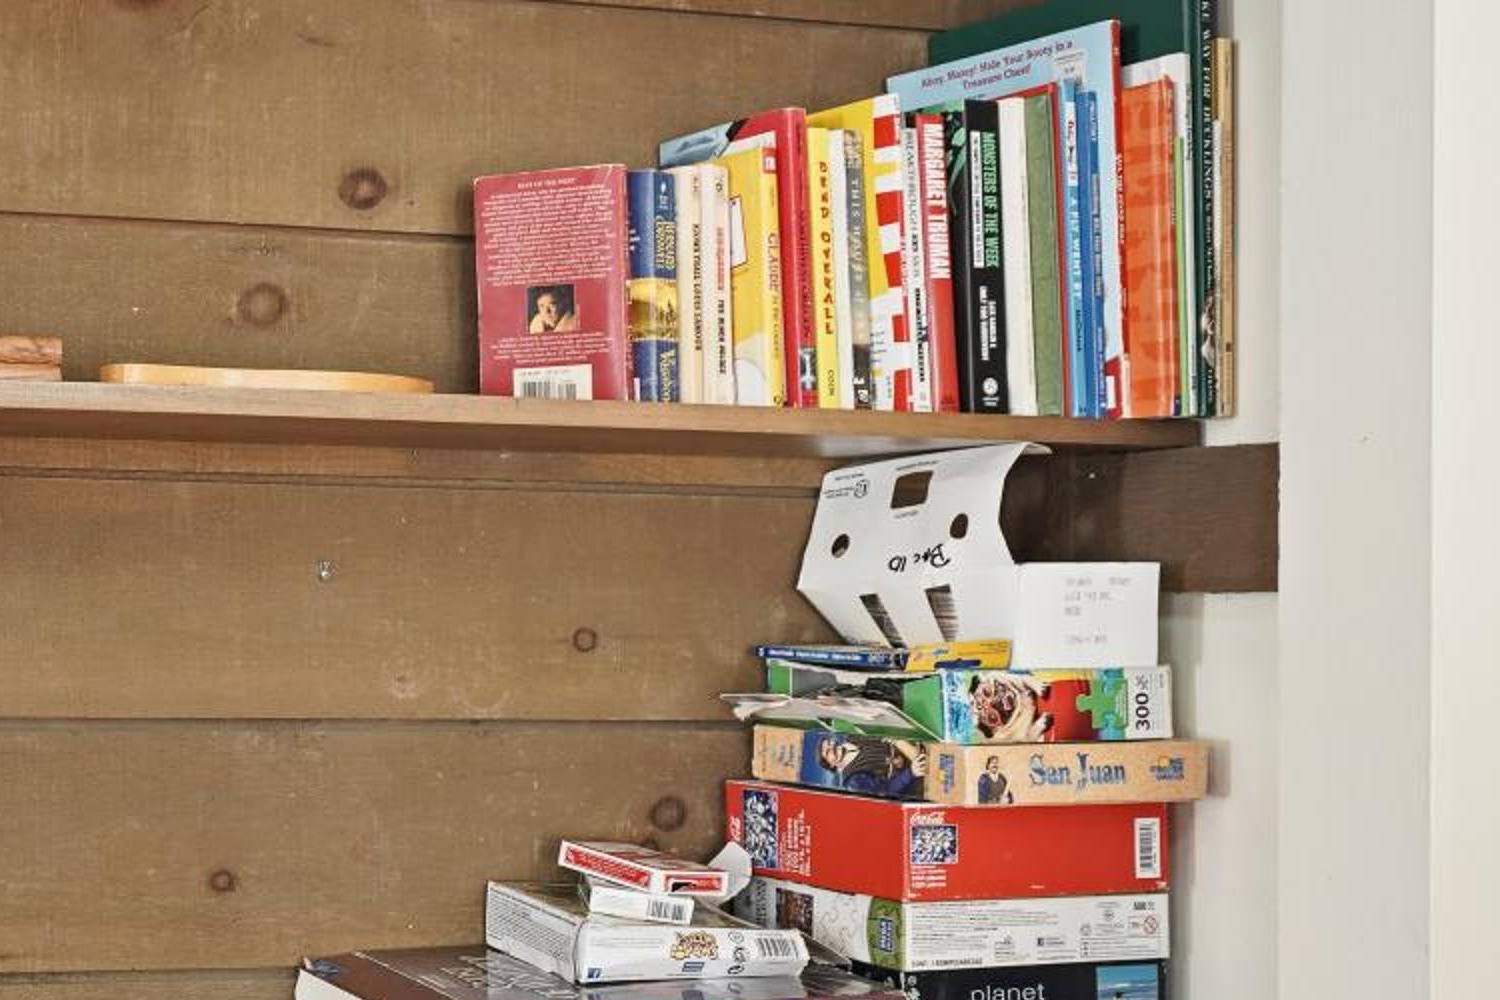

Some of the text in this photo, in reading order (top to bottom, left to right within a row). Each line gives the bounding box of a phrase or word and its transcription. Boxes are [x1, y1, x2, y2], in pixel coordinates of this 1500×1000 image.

[923, 122, 950, 279] MARGARET TRUMAN
[982, 132, 999, 268] MONSTERS OF THE WEEK
[1135, 692, 1151, 732] 300
[1029, 752, 1073, 787] San
[1076, 751, 1126, 792] Juan
